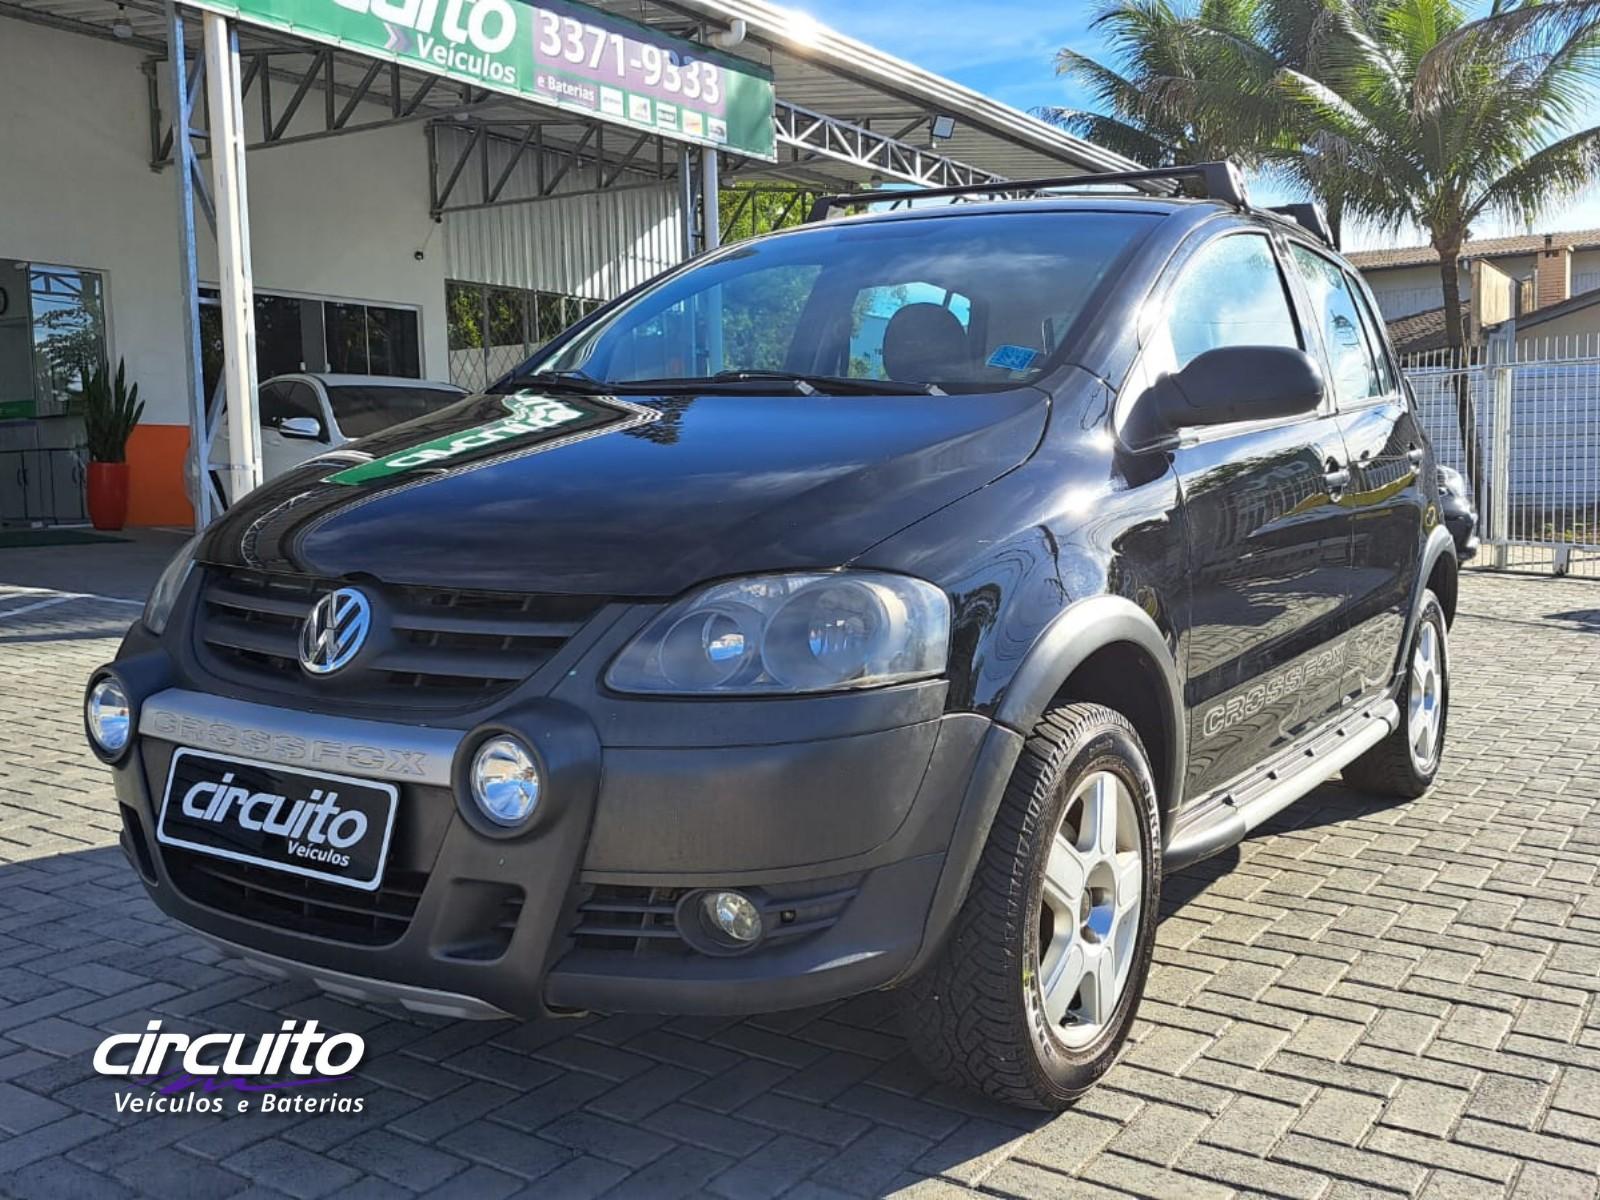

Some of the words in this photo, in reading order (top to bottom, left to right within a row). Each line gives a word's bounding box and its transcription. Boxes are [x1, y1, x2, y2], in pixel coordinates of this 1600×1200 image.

[416, 33, 516, 83] Veículos
[539, 10, 719, 104] 3371-9333
[547, 75, 594, 101] Baterias
[152, 710, 427, 776] CROSSFOX
[182, 772, 368, 848] circuito
[287, 840, 350, 867] Veículos
